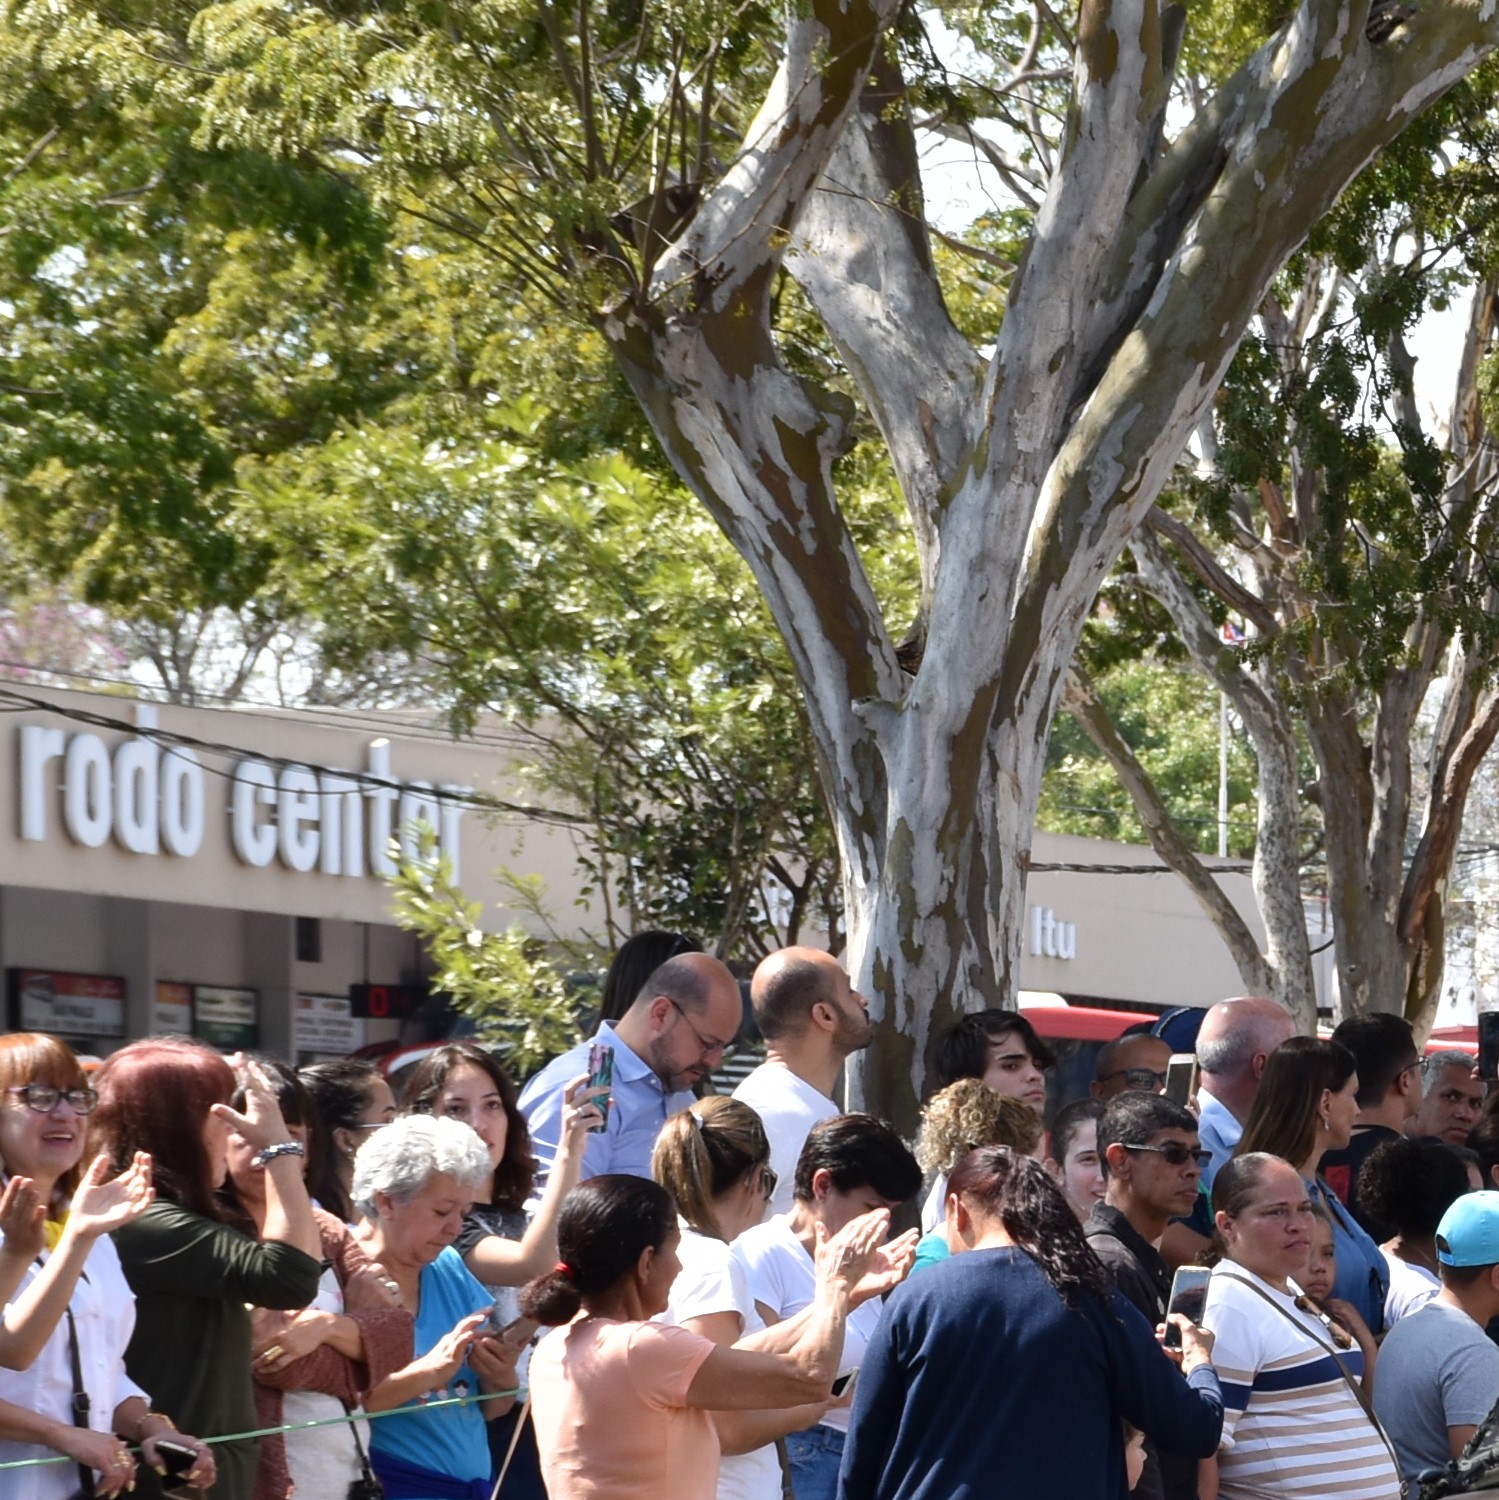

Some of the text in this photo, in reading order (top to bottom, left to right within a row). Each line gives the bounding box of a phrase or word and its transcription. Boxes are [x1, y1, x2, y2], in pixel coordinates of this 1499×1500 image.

[20, 704, 475, 887] rodo center
[1031, 906, 1076, 960] Itu
